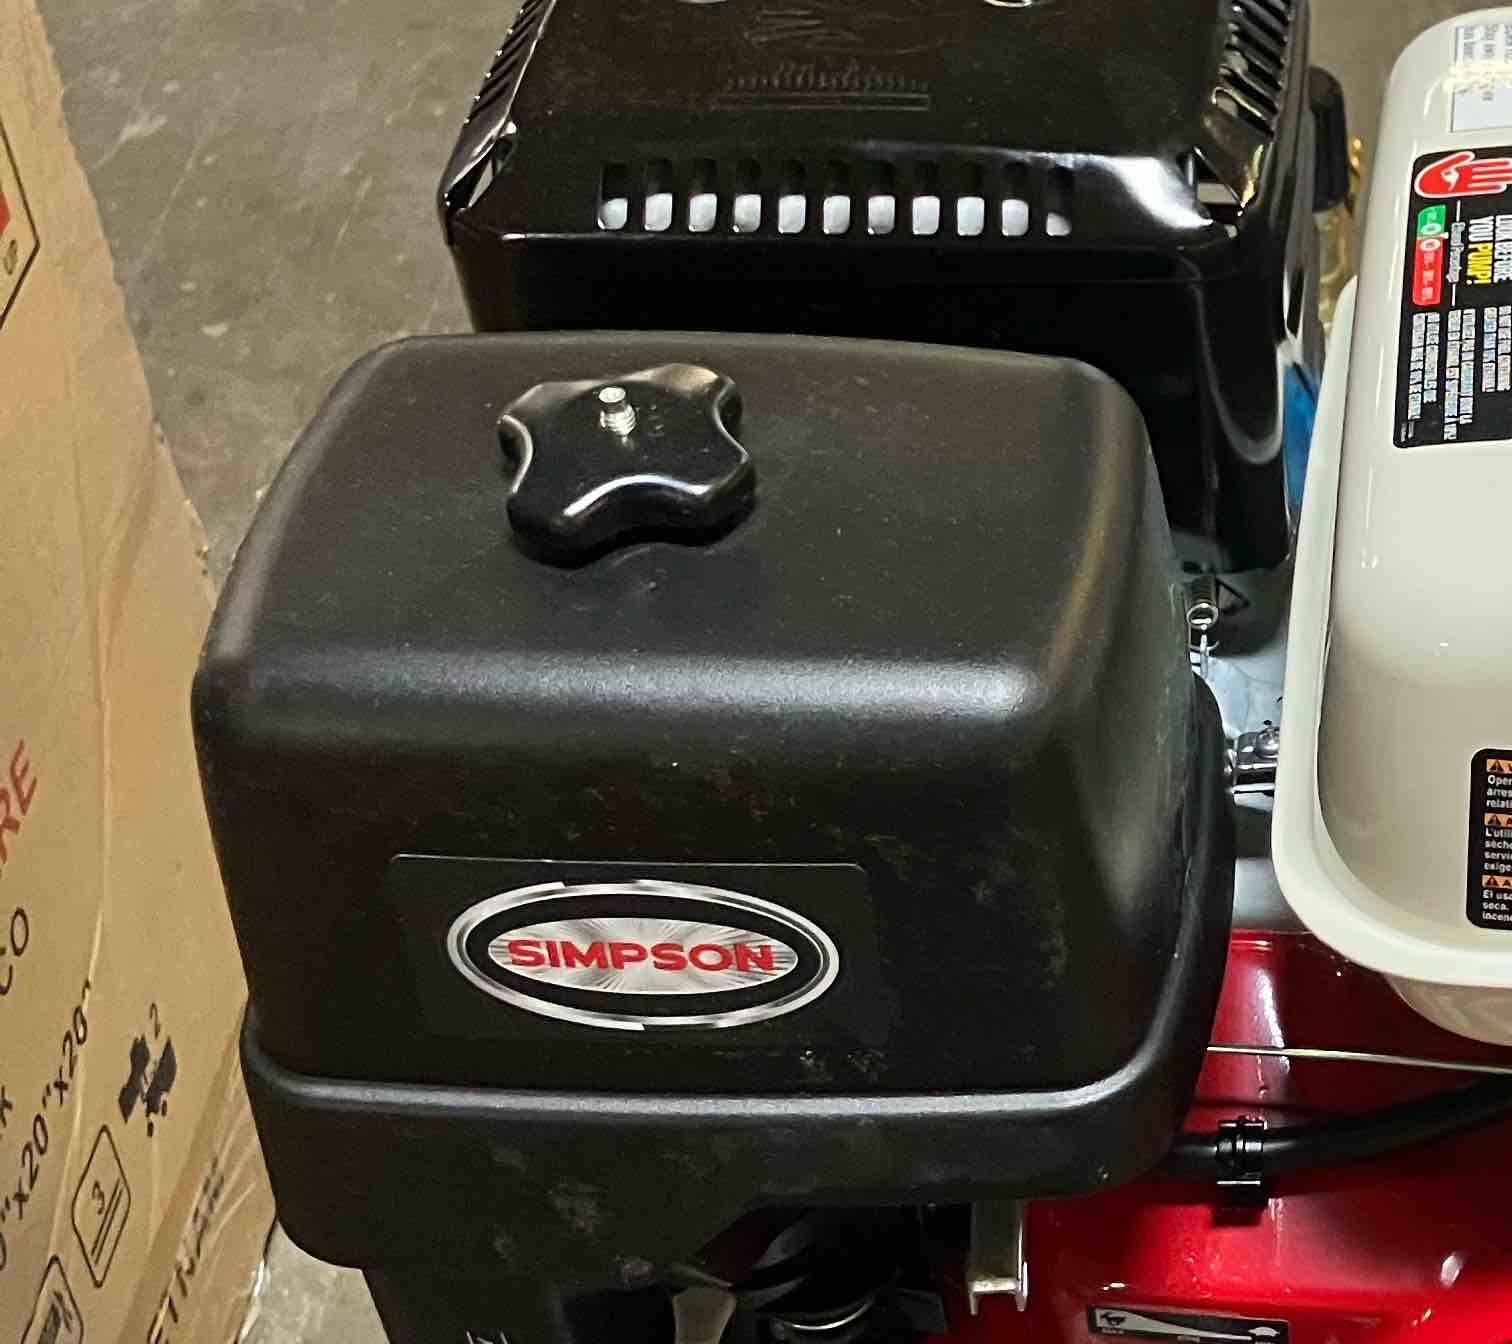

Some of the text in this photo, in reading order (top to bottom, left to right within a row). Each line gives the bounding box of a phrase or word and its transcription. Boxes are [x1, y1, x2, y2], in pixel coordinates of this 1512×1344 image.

[1469, 216, 1495, 241] YOU
[1466, 243, 1493, 285] PUMP!
[506, 938, 777, 973] SIMPSON
